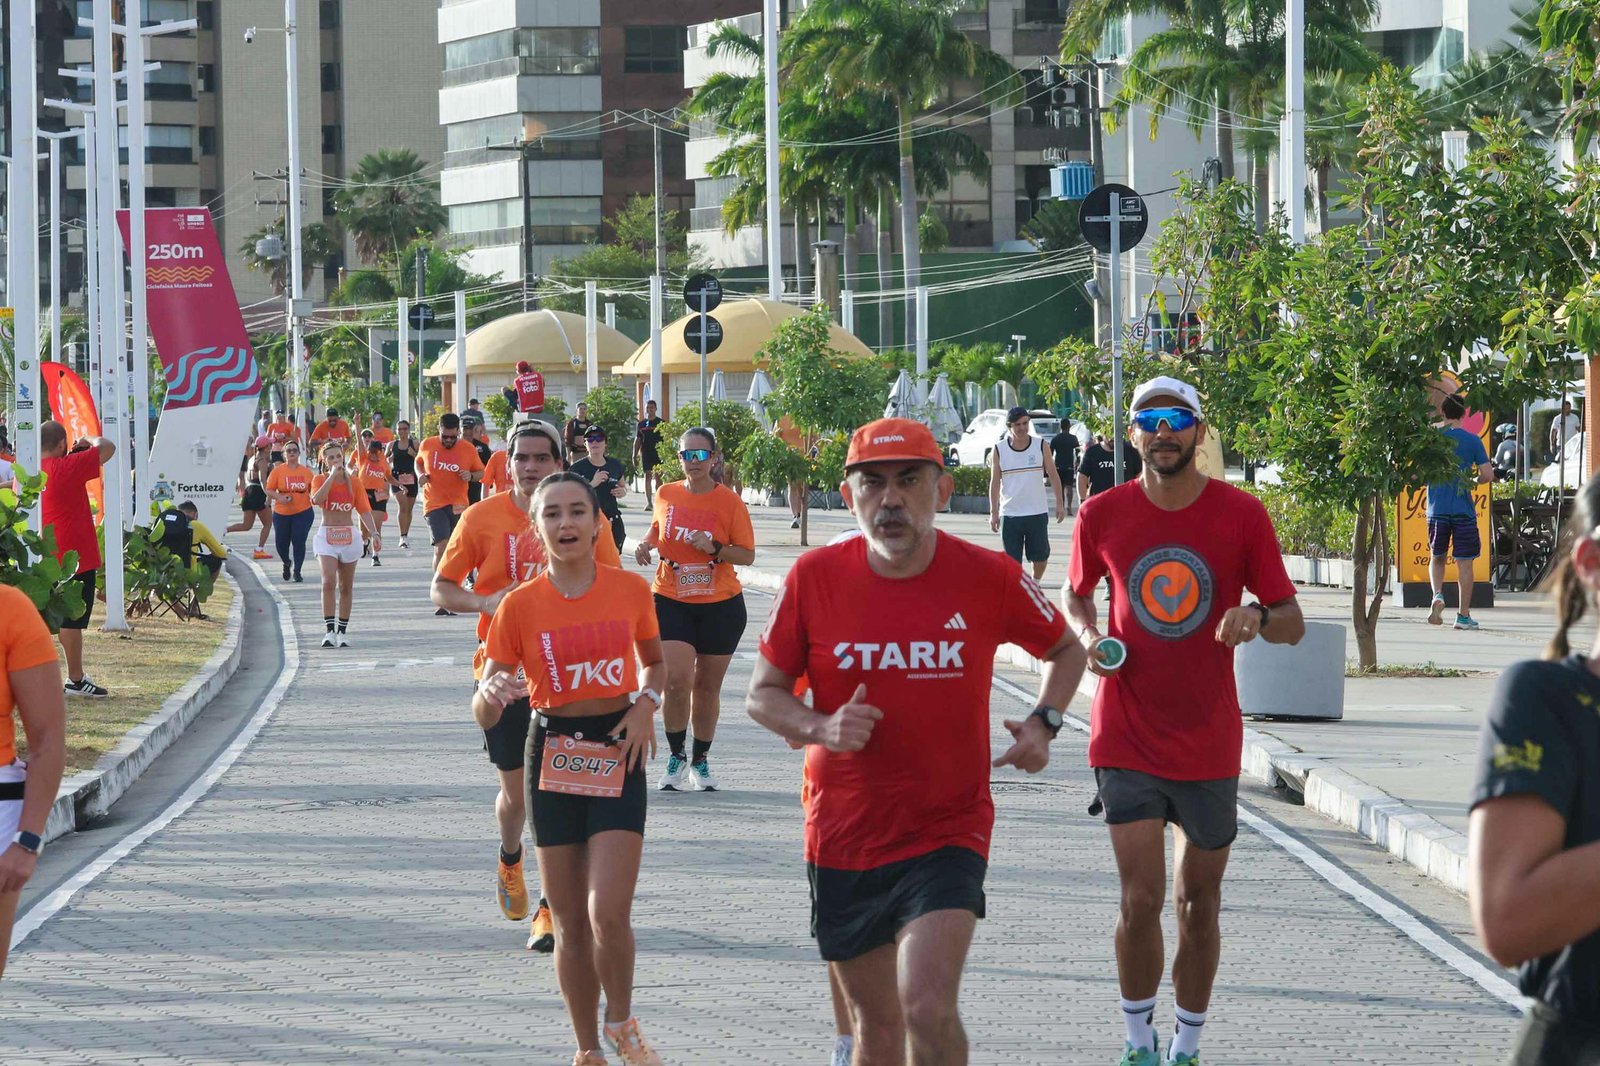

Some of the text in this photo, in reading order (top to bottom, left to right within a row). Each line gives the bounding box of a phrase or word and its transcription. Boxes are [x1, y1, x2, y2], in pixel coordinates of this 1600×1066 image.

[148, 243, 204, 260] 250m
[873, 434, 905, 445] STRAVA
[177, 482, 224, 493] Fortaleza
[508, 534, 518, 581] CHALLENGE
[541, 632, 563, 694] CHALLENGE
[833, 641, 966, 671] STARK
[550, 752, 619, 776] 0847
